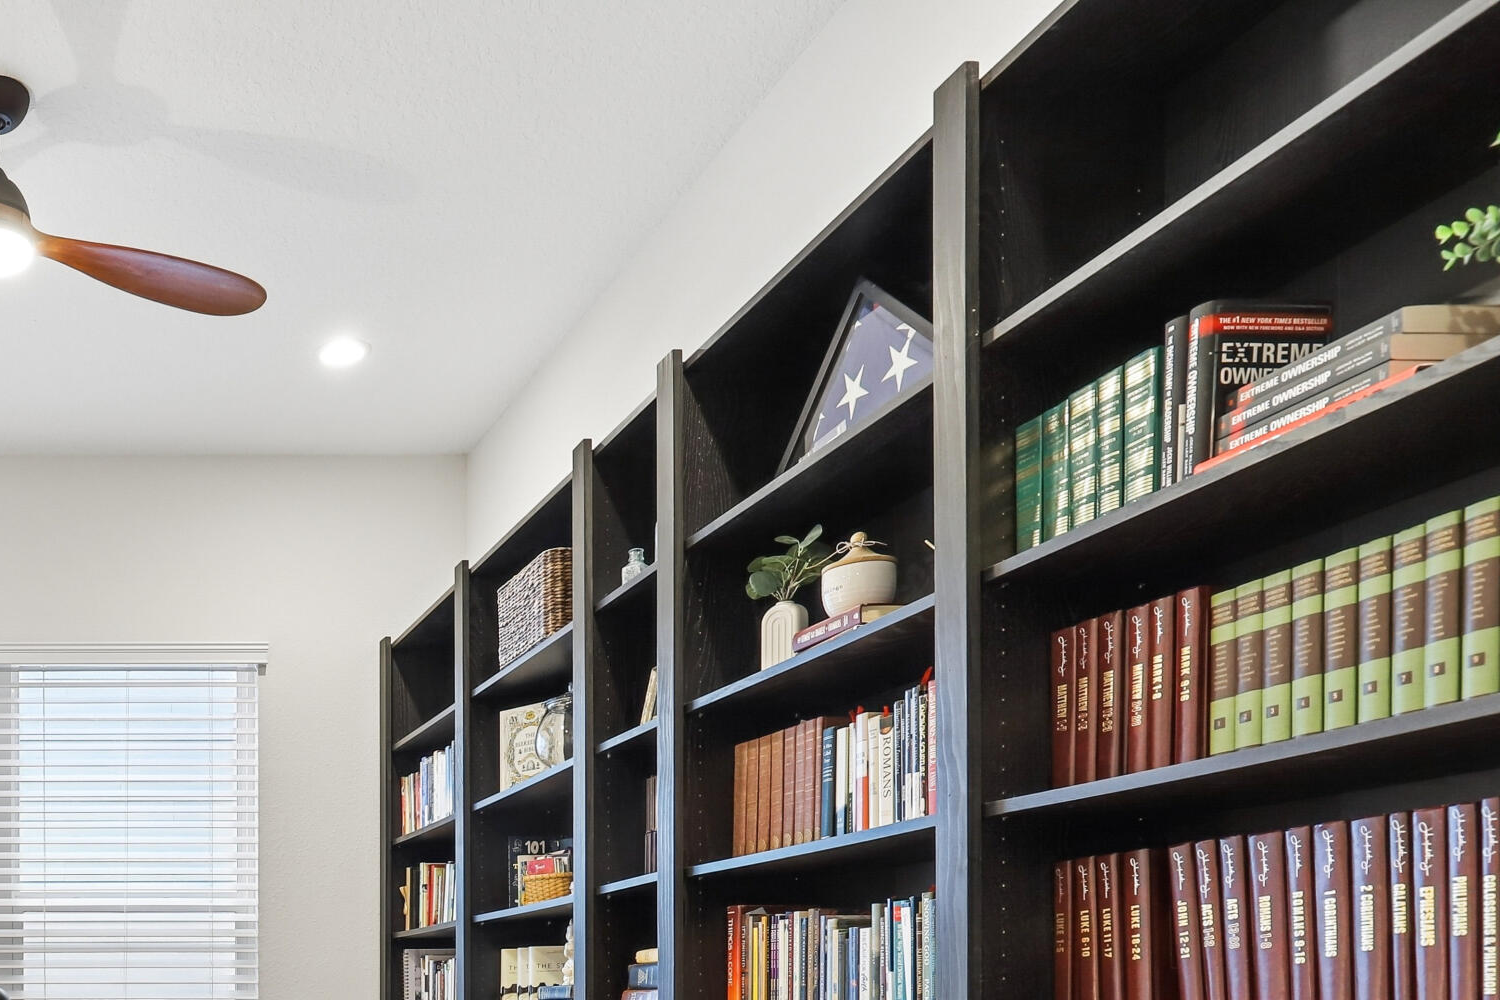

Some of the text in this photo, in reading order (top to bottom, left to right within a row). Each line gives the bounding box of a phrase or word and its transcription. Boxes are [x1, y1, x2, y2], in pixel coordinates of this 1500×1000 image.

[1185, 317, 1199, 435] EXTREME OWNERSHIP
[1231, 399, 1270, 426] EXTREME
[1272, 370, 1332, 407] OWNERSHIP
[1239, 376, 1279, 402] EXTREME
[1281, 345, 1342, 383] OWNERSHIP
[1164, 398, 1173, 443] LEADERSHIP
[1229, 396, 1330, 450] EXTREME OWNERSHIP
[1078, 676, 1089, 712] MATTHEW
[1102, 670, 1114, 708] MATTHEW
[1131, 664, 1144, 700] MATTHEW
[1152, 654, 1163, 684] MARK
[1180, 646, 1191, 702] MARK 9-16
[1057, 684, 1068, 718] MATTHEW
[882, 736, 892, 798] ROMANS
[524, 840, 545, 854] 101
[1055, 912, 1064, 936] LUKE
[1177, 900, 1190, 960] JOHN 12-21
[1201, 904, 1214, 927] ACTS
[1226, 898, 1238, 920] ACTS
[1259, 895, 1272, 949] ROMANS 1-8
[1292, 891, 1306, 965] ROMANS 9-16
[1324, 897, 1338, 958] CORINTHIANS
[1360, 884, 1374, 952] 2 CORINTHIANS
[1392, 883, 1407, 934] GALATIANS
[1419, 886, 1436, 947] EPHESIANS
[1452, 875, 1468, 937] PHILIPPIANS
[1483, 874, 1497, 936] COLOSSIANS
[1079, 909, 1090, 958] LUKE 6-10
[1102, 908, 1113, 958] LUKE 11-17
[1130, 905, 1141, 961] LUKE 18-24
[1483, 945, 1497, 995] PHILEMON
